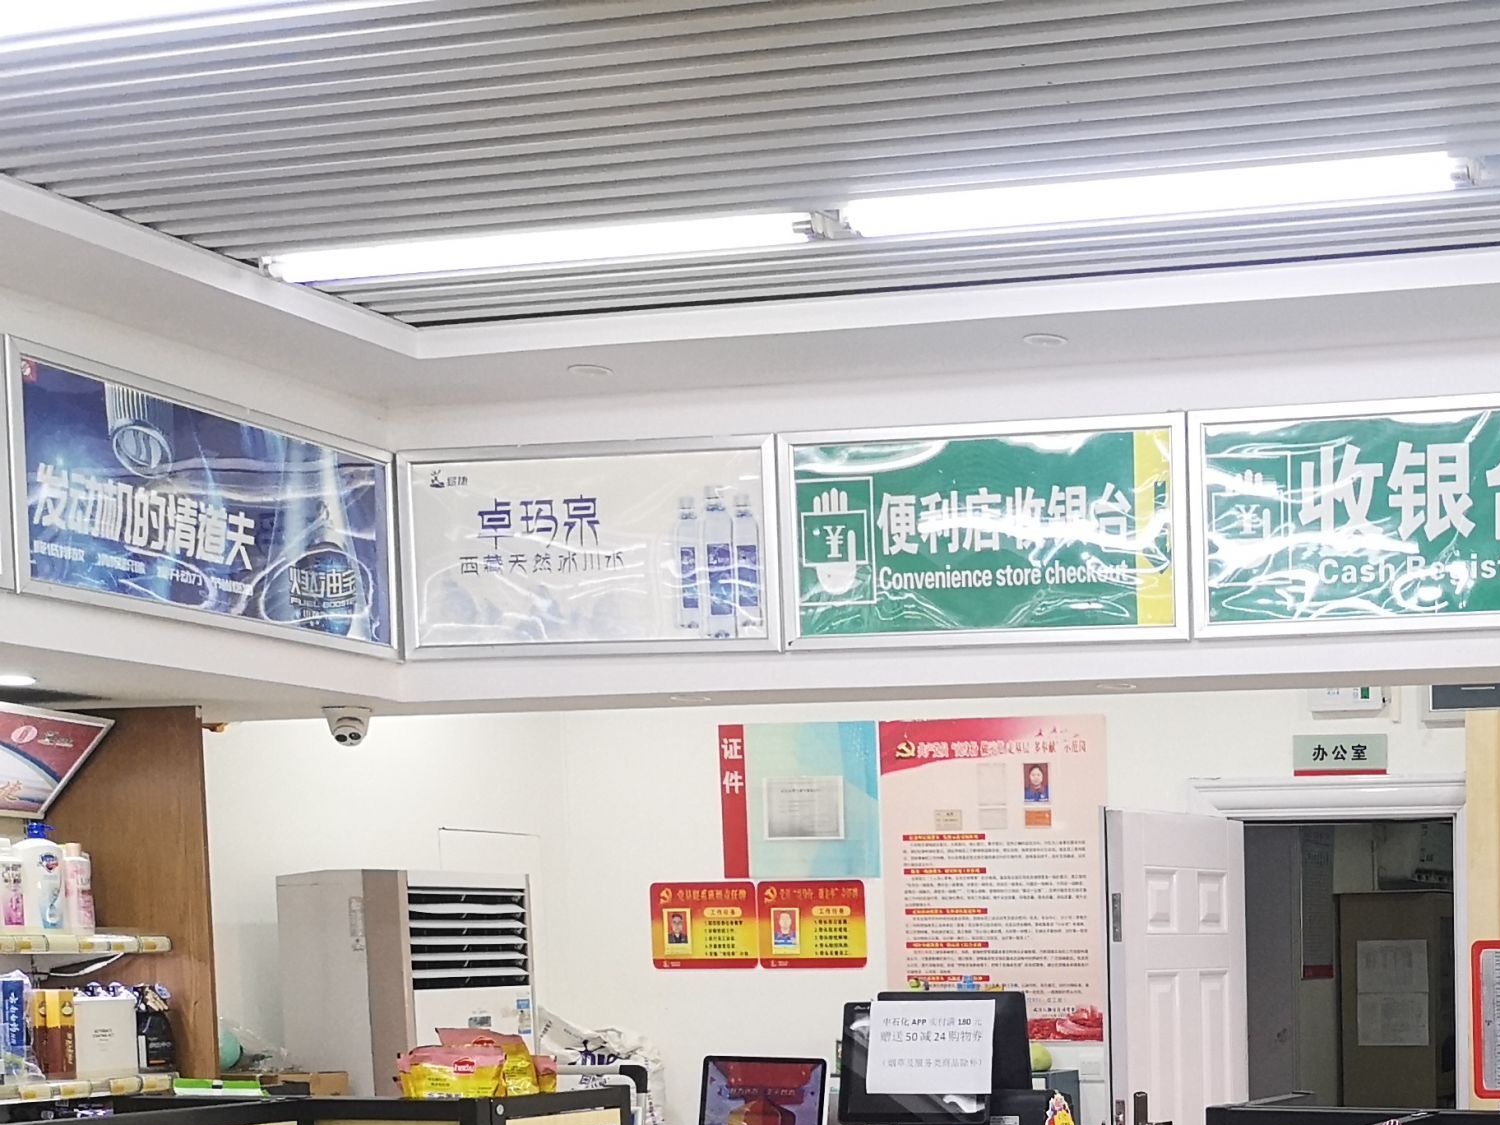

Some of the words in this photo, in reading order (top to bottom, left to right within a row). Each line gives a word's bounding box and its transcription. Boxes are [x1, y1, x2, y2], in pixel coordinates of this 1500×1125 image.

[32, 462, 256, 570] 发动机的清道夫
[477, 494, 600, 550] 卓玛泉
[877, 483, 1131, 555] 便利店收银台
[459, 551, 625, 576] 西藏天然冰川水
[879, 564, 992, 592] Convenience
[996, 564, 1042, 586] store
[1045, 560, 1129, 586] checkout
[1319, 556, 1395, 585] Cash
[721, 737, 744, 795] 证件
[1312, 744, 1368, 761] 办公室
[905, 1032, 918, 1042] 50
[934, 1032, 946, 1041] 24
[911, 1018, 927, 1026] APP
